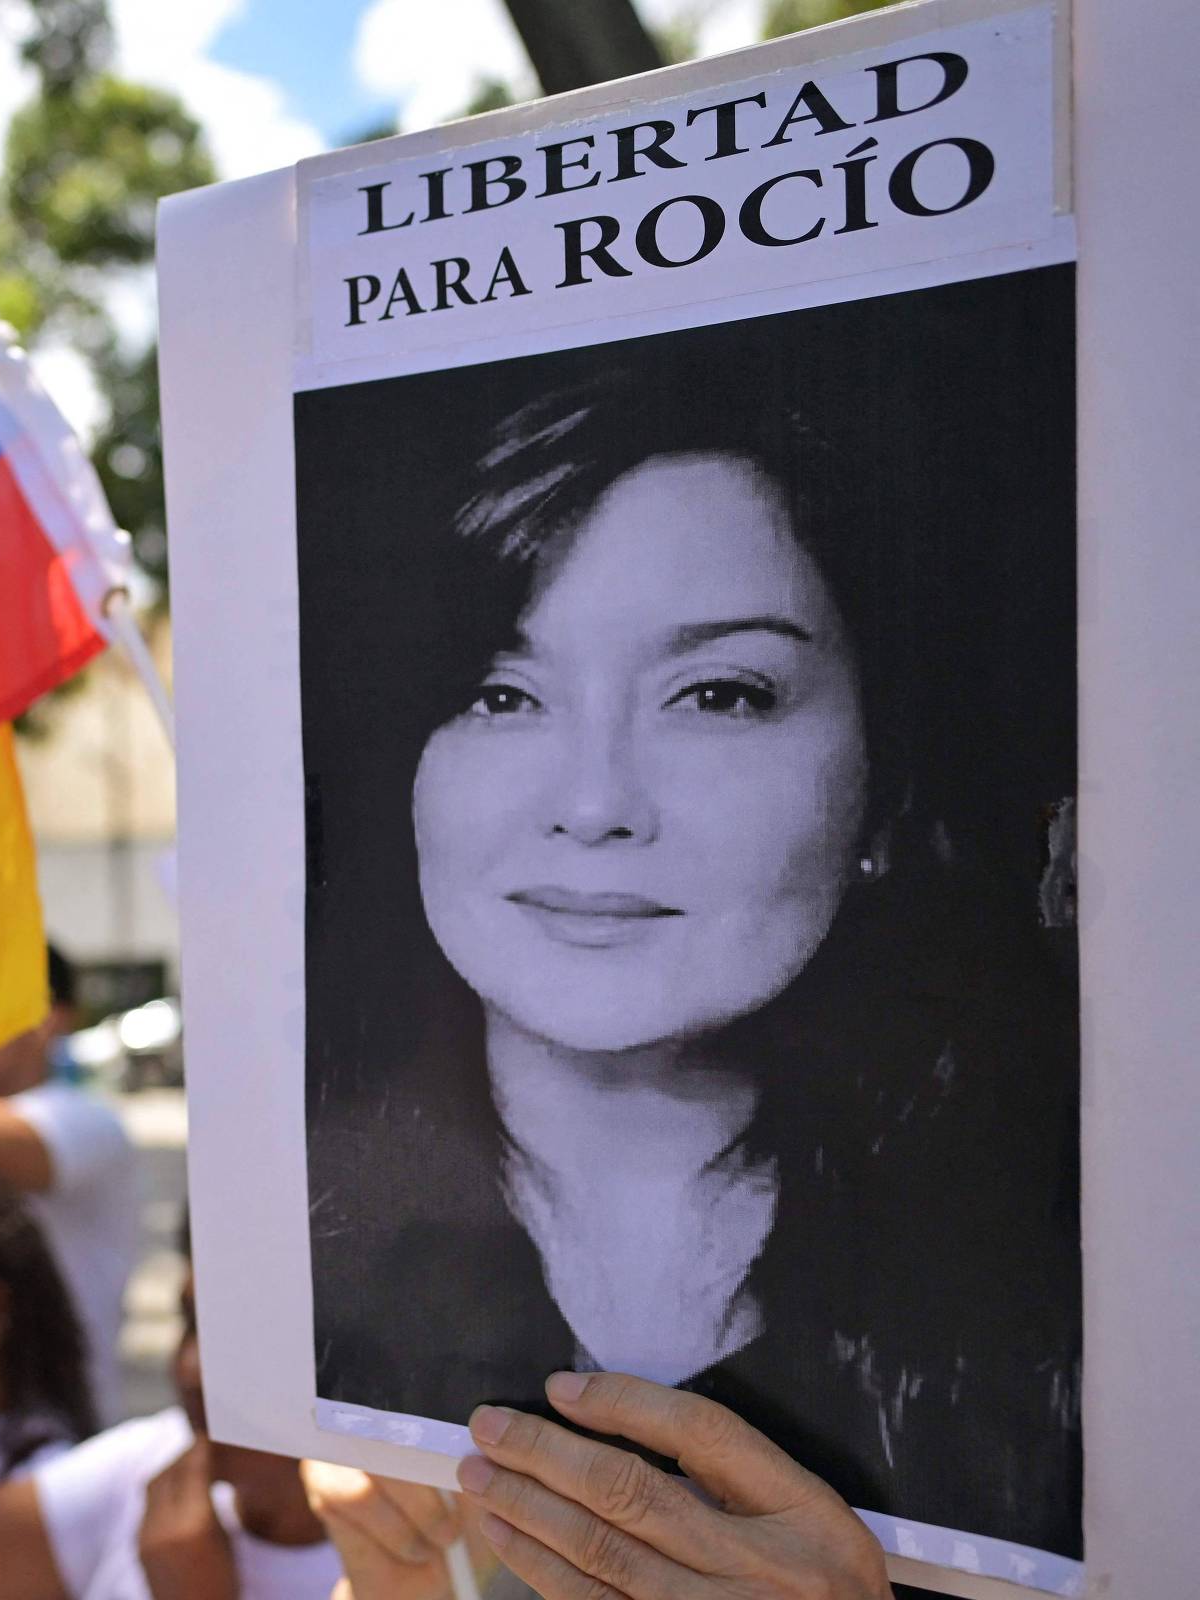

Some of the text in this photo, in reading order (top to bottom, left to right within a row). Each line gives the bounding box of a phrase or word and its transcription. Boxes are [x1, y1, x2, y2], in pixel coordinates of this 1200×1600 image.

[343, 136, 995, 327] PARA ROCÍO
[357, 51, 970, 236] LIBERTAD
